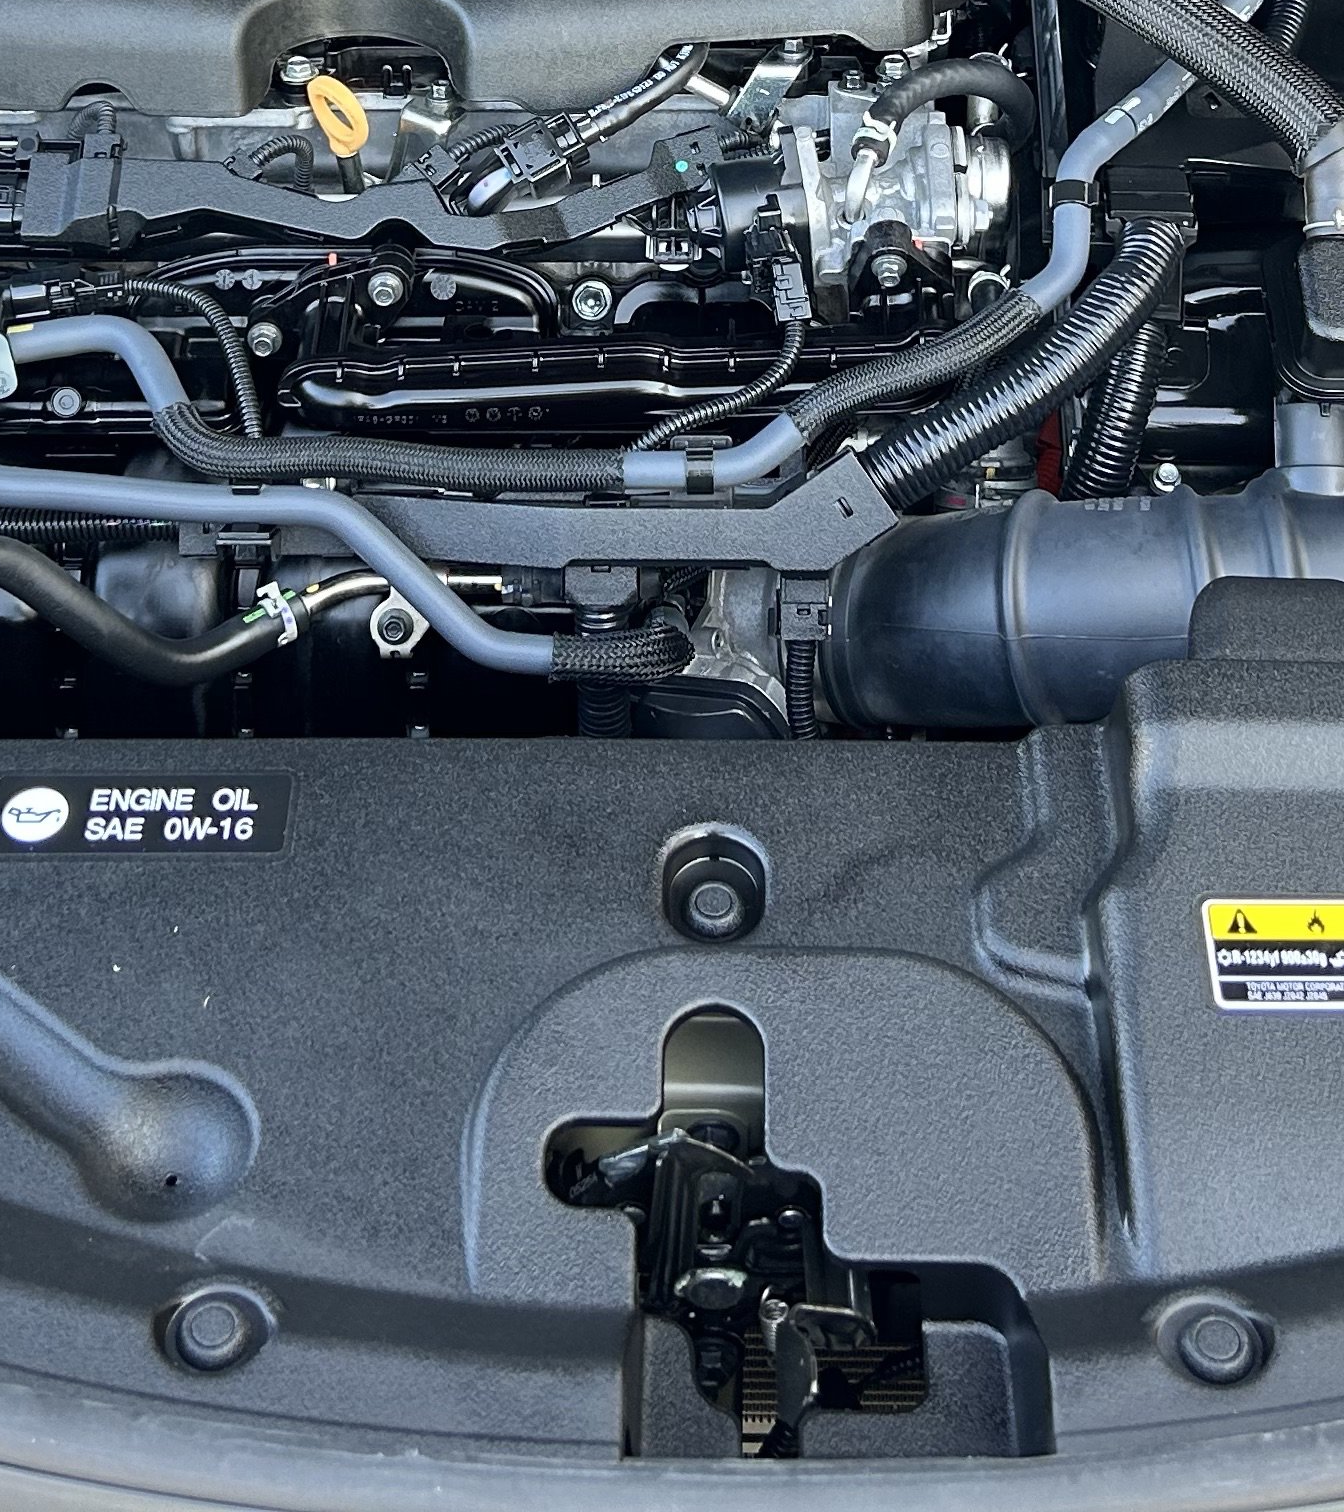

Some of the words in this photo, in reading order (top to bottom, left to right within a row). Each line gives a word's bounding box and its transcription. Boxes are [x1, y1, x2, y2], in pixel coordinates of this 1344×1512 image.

[89, 787, 196, 812] ENGINE
[211, 787, 259, 812] OIL
[83, 817, 146, 841] SAE
[163, 817, 254, 841] 0W-16
[1246, 981, 1277, 992] TOYOTA
[1276, 981, 1305, 992] MOTOR
